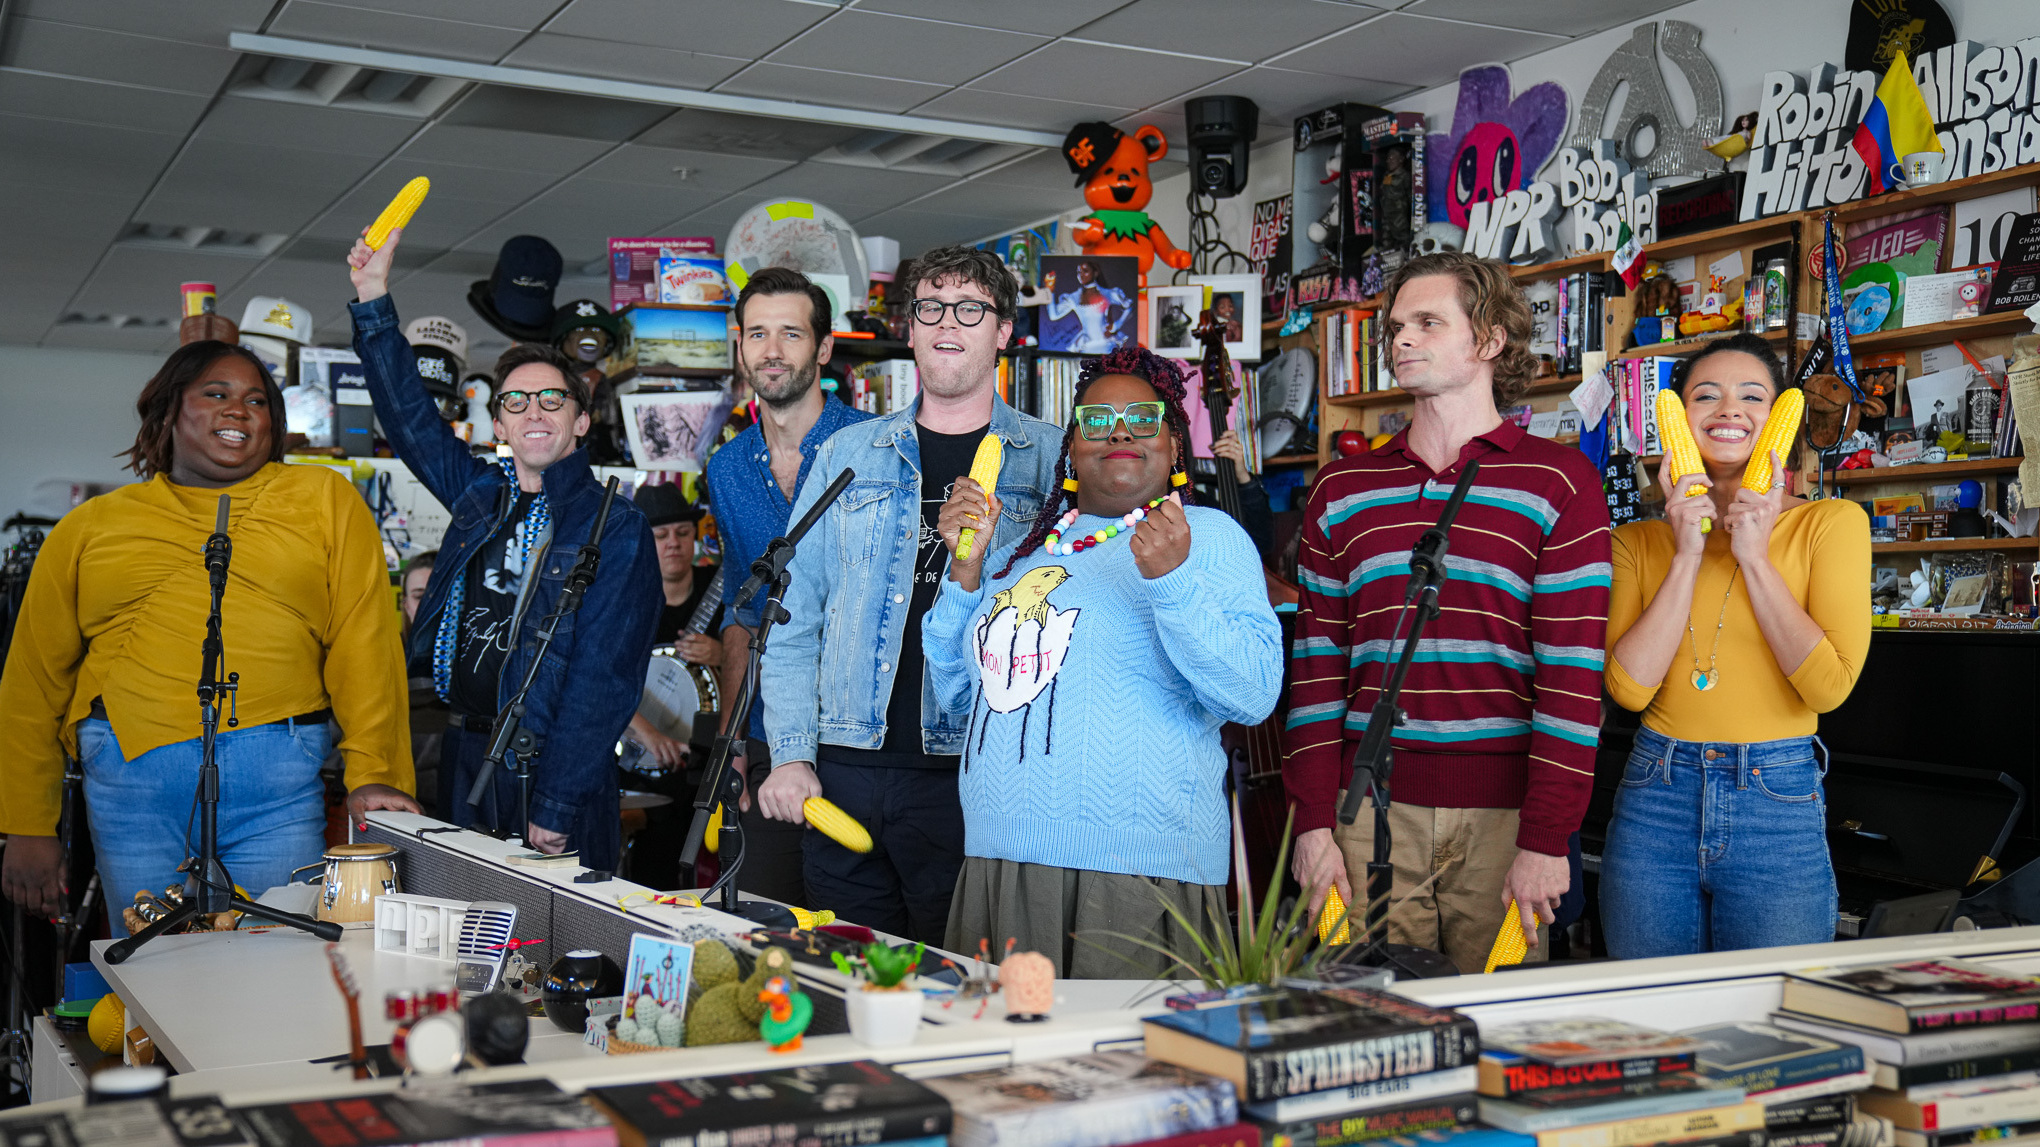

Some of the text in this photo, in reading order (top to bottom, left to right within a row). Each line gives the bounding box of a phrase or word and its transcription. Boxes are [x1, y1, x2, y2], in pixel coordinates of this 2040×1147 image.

[1751, 62, 1875, 149] Robin
[1414, 135, 1424, 187] MASTER
[1559, 139, 1619, 207] Bob
[1256, 198, 1292, 224] NO ME
[1659, 189, 1735, 227] RECORDING
[1253, 216, 1289, 242] DIGAS
[1463, 182, 1556, 262] NPR
[1251, 238, 1277, 260] QUE
[1869, 229, 1905, 264] LED
[2023, 253, 2040, 262] LIFE
[666, 268, 714, 290] Twinkies
[1262, 272, 1288, 297] ILAS
[1298, 273, 1332, 300] KISS
[1995, 297, 2011, 306] BOB
[1645, 422, 1657, 456] CALL
[1612, 505, 1634, 519] 9:30
[981, 647, 1052, 678] MON PETIT
[1286, 1030, 1435, 1095] SPRINGSTEEN
[1347, 1079, 1410, 1099] BIG EARS
[1503, 1064, 1550, 1092] THIS
[1583, 1061, 1623, 1081] CALL
[1316, 1120, 1341, 1139] THE
[1342, 1116, 1367, 1137] DIY
